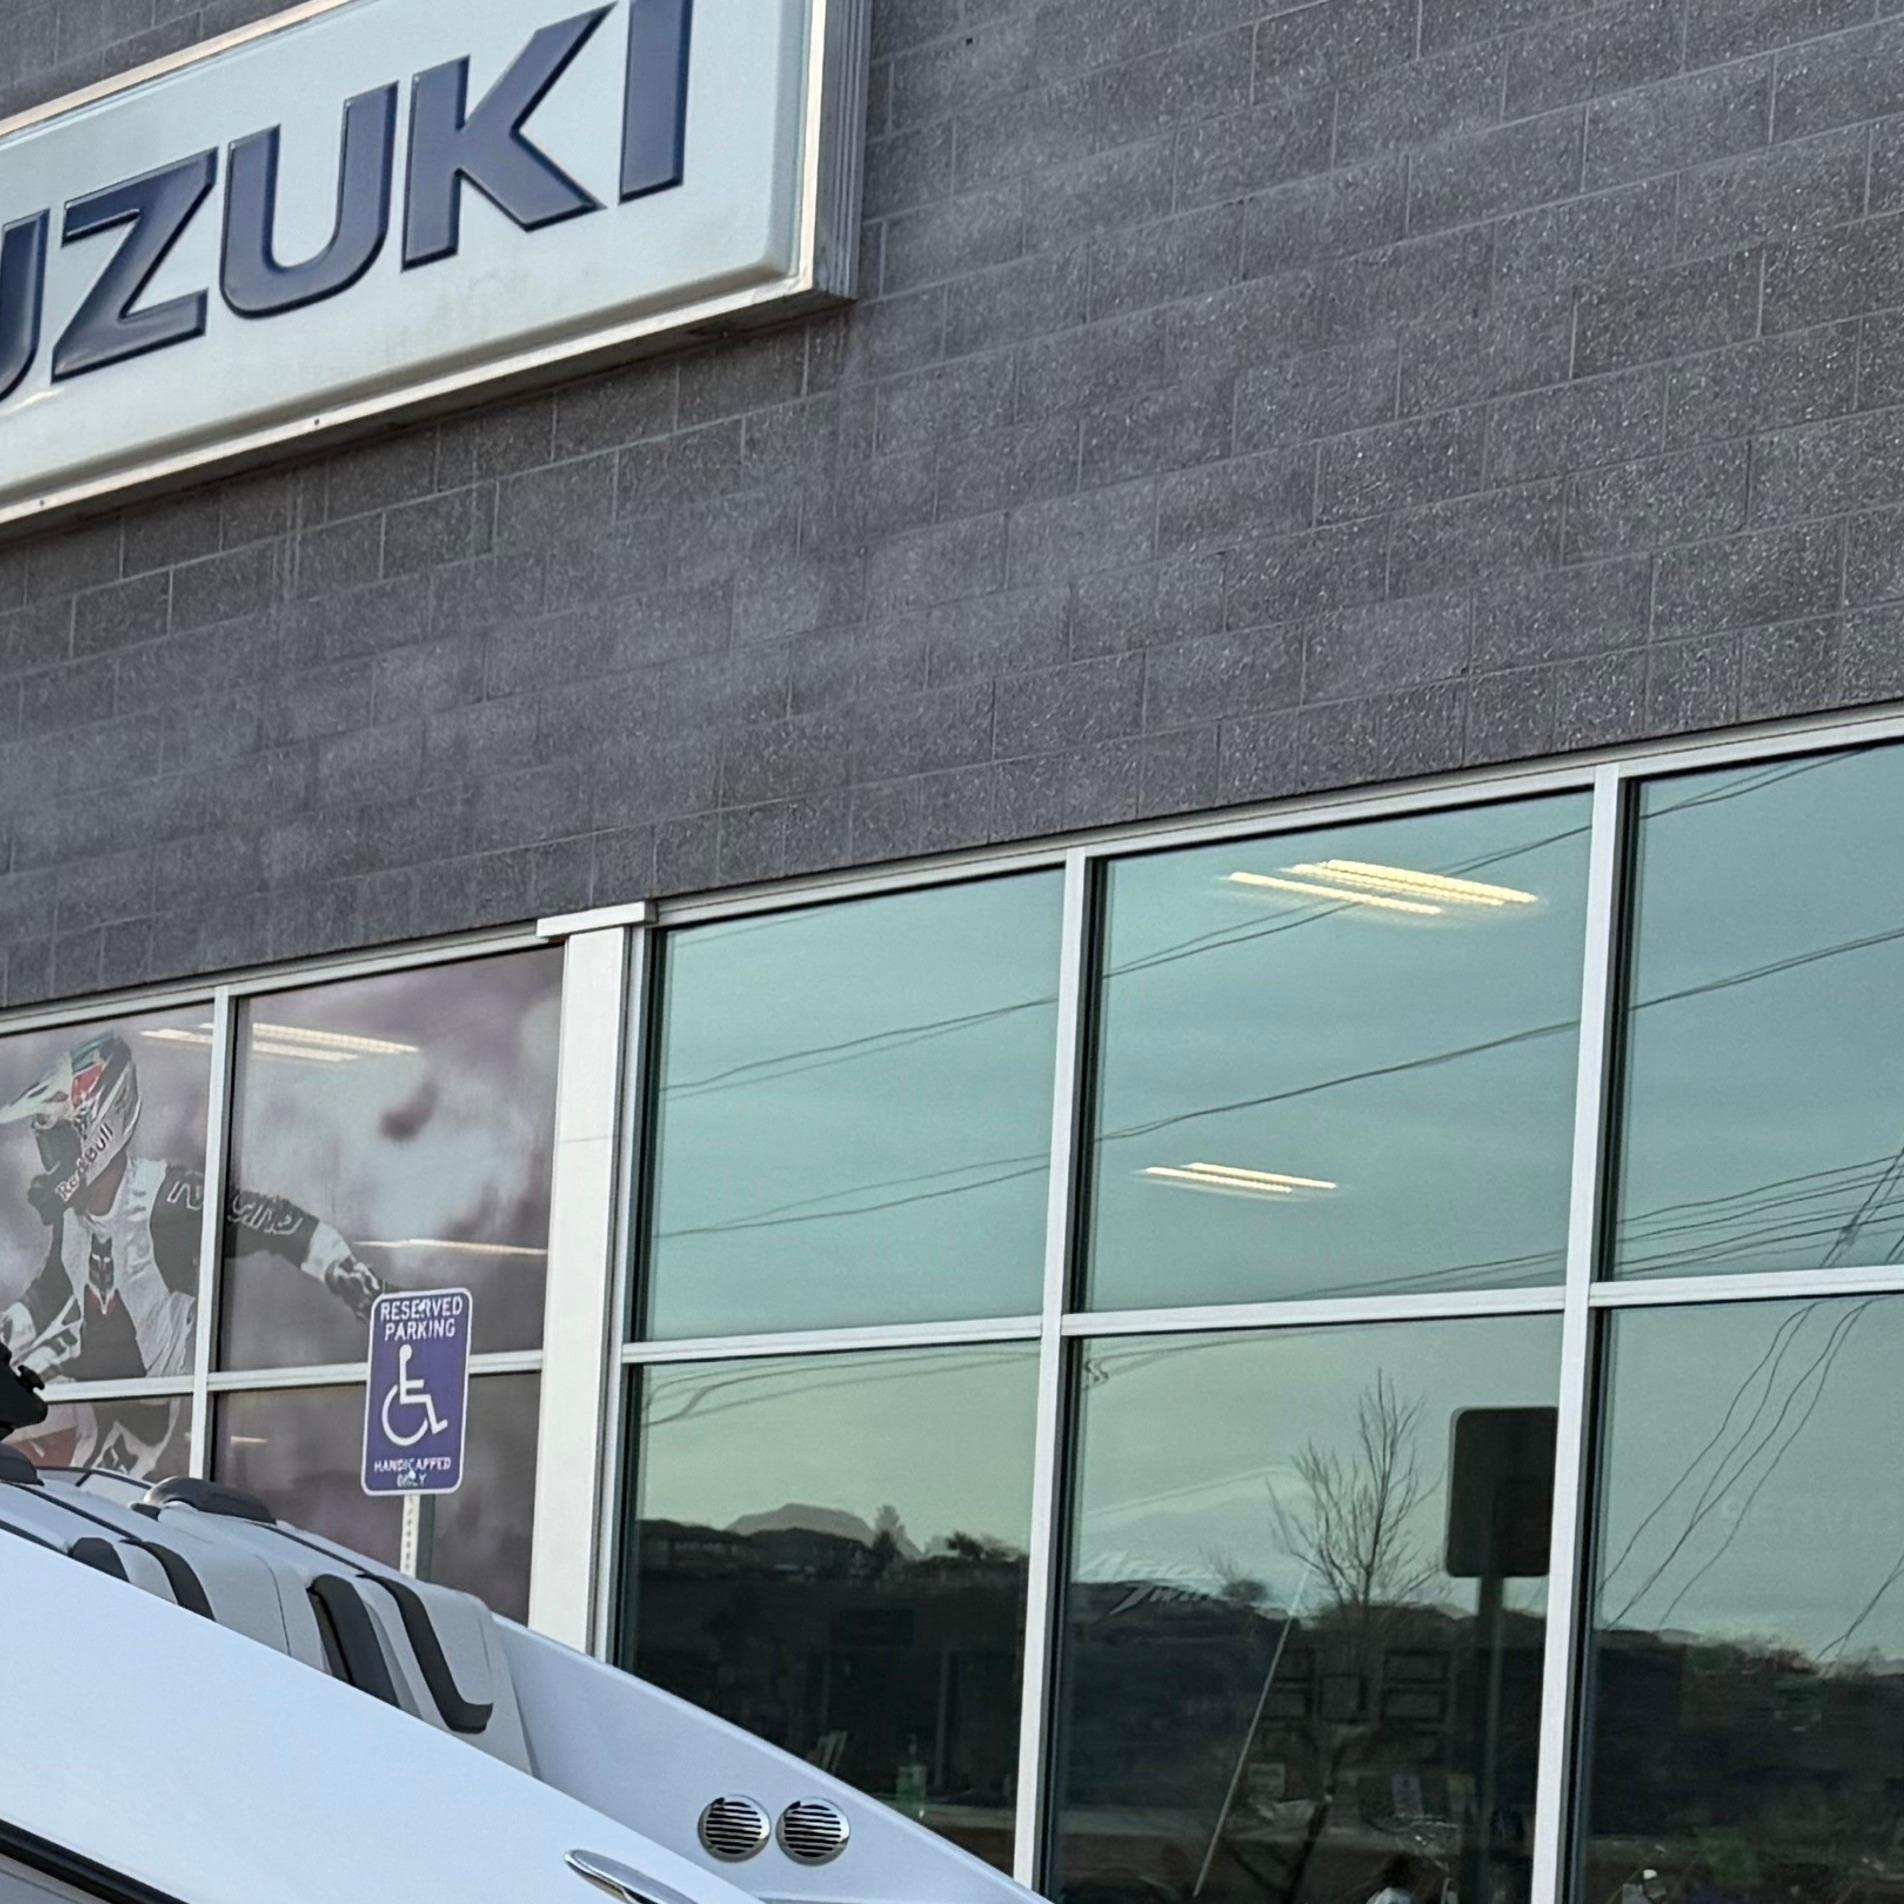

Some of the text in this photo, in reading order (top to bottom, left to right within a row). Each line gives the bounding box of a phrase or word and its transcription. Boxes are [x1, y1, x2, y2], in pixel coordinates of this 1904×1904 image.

[379, 1295, 463, 1322] RESERVED
[384, 1317, 456, 1342] PARKING
[373, 1456, 452, 1473] HANDICAPPED
